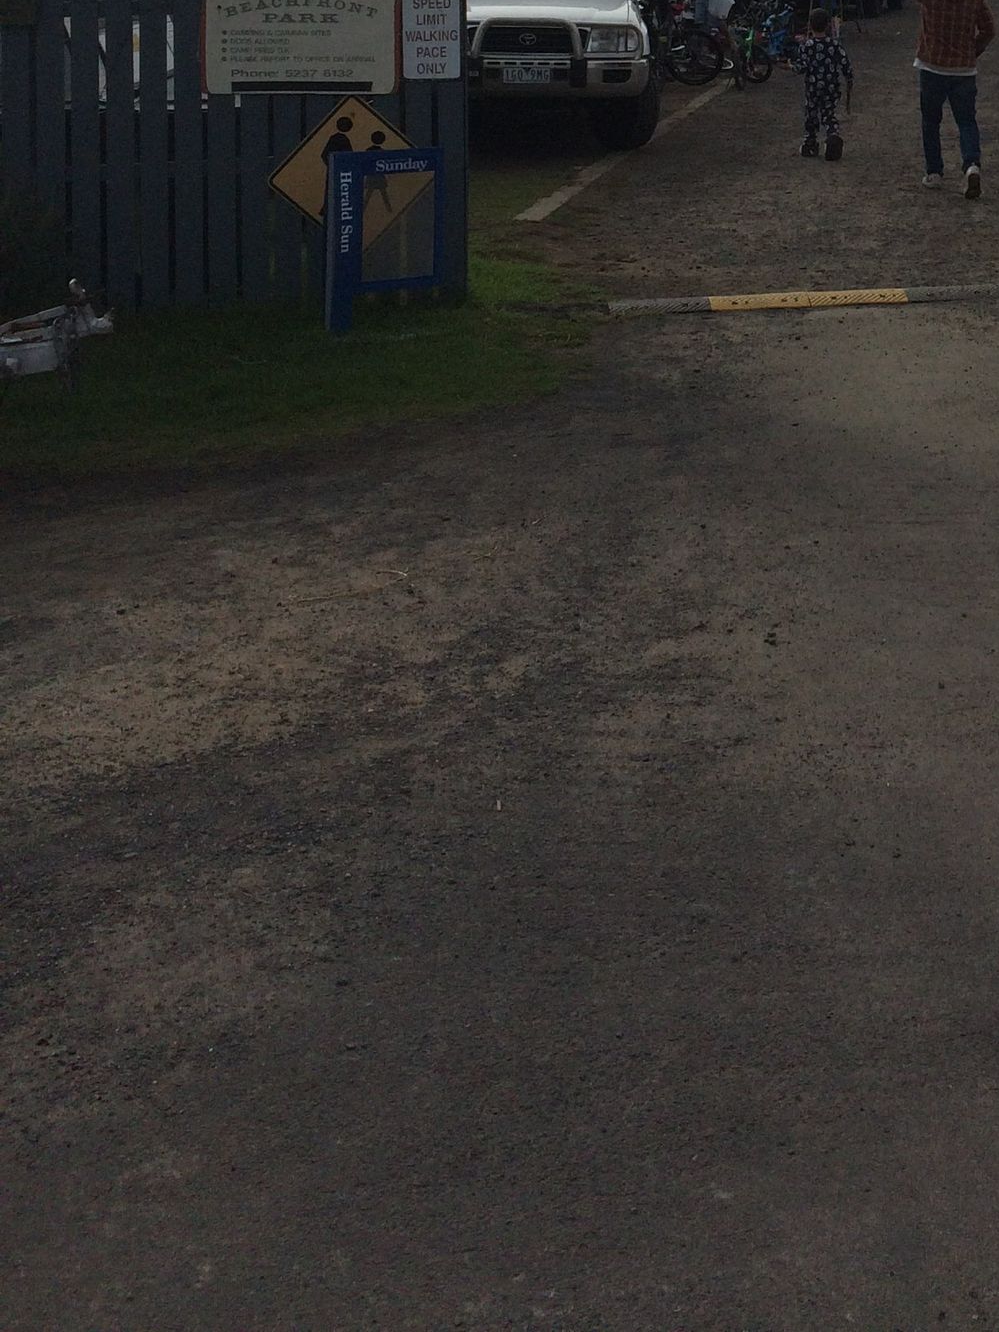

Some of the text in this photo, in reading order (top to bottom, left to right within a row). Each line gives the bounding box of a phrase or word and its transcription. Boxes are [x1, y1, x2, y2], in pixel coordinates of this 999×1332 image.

[262, 12, 340, 23] PARK
[416, 14, 448, 25] LIMIT
[405, 29, 458, 41] WALKING
[416, 47, 447, 58] PACE
[285, 69, 318, 78] 5237
[416, 62, 448, 74] ONLY
[375, 157, 428, 172] Sunday
[340, 171, 353, 253] Herald Sun
